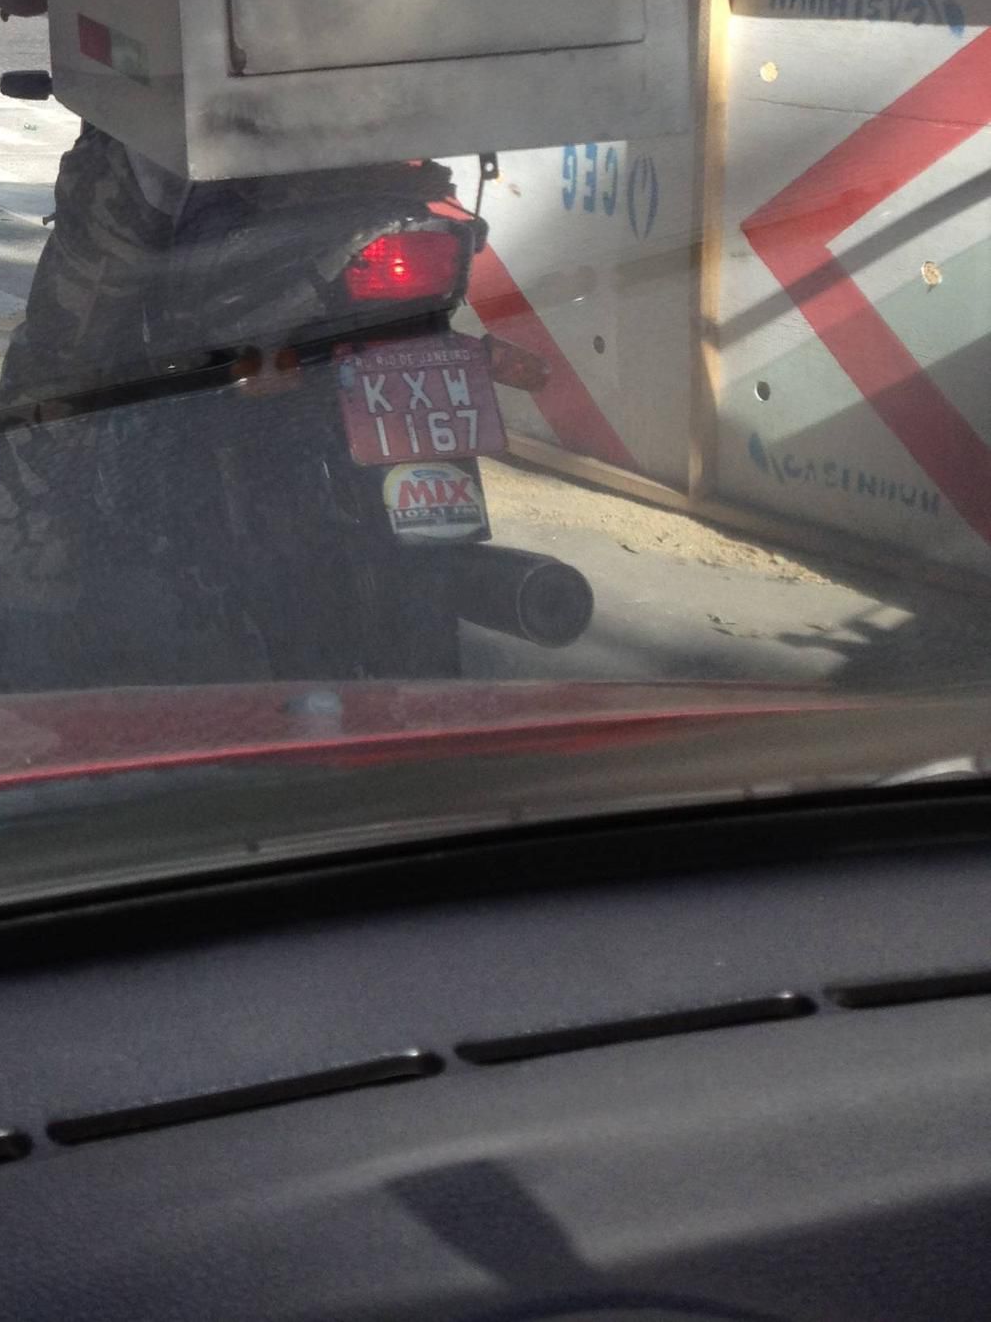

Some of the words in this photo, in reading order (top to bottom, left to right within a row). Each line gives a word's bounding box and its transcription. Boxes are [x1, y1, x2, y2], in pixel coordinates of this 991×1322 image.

[562, 142, 618, 216] CEG
[376, 355, 396, 367] RIO
[399, 353, 415, 365] DE
[418, 349, 472, 366] JANEIRO
[362, 369, 472, 414] KXW
[375, 409, 478, 456] 1167
[398, 477, 474, 509] MIX
